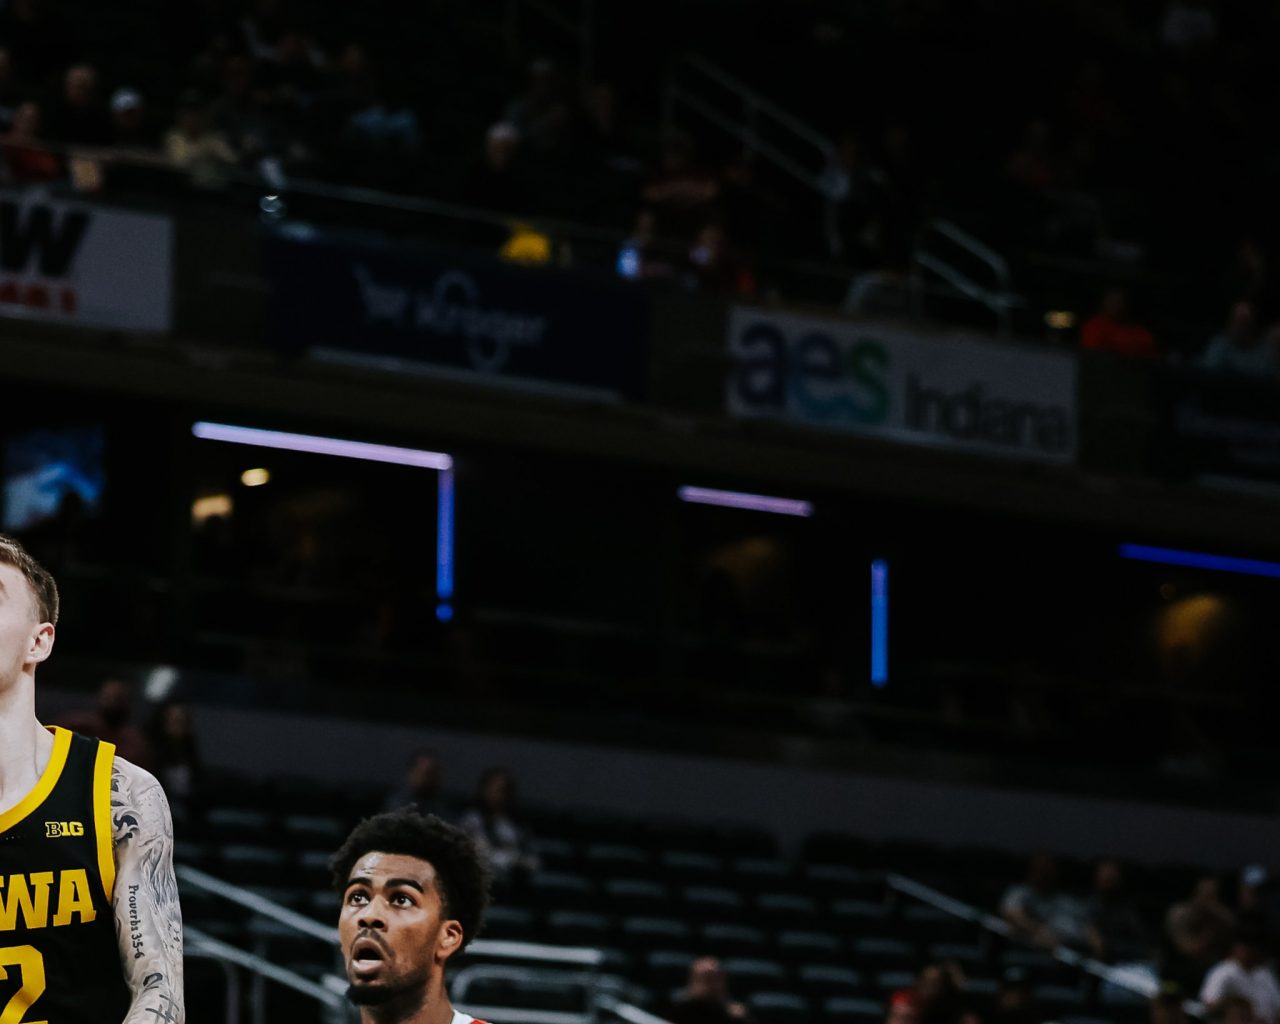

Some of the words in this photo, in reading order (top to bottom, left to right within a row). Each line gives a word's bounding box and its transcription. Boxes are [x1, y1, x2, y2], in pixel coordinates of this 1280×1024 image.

[735, 323, 889, 424] aes
[904, 372, 1068, 450] Indiana
[128, 884, 141, 931] Proverbs
